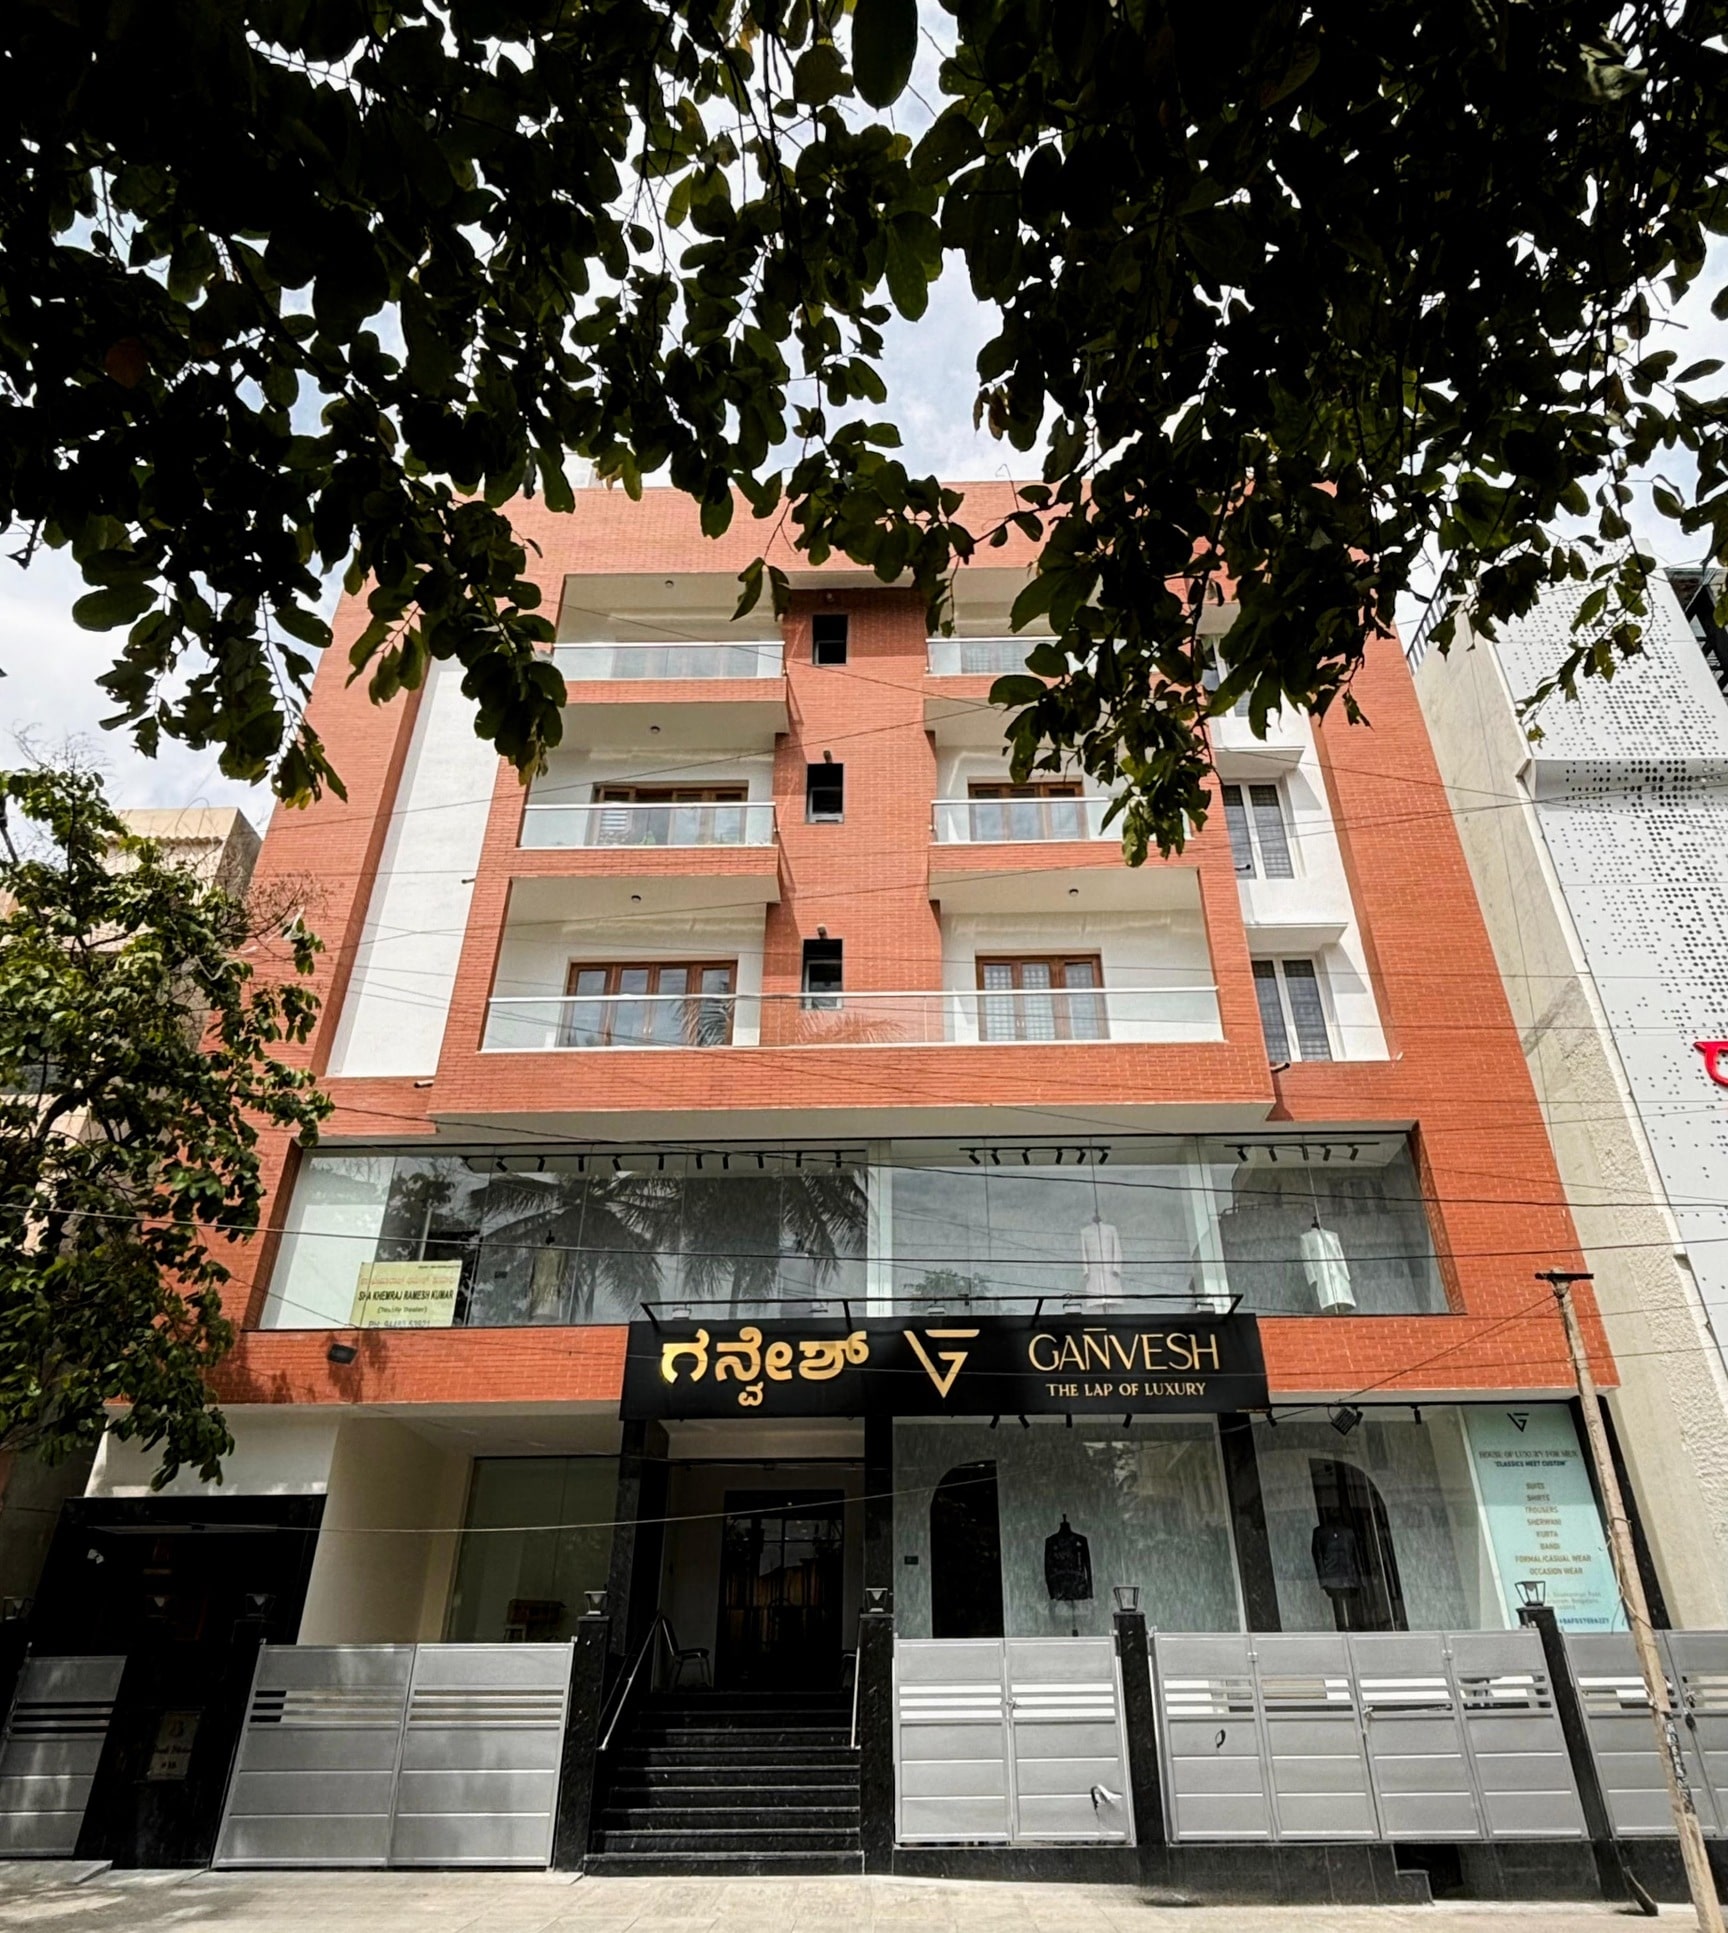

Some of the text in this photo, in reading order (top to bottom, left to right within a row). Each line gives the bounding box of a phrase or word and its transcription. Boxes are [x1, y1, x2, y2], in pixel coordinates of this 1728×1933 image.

[373, 1291, 402, 1301] KHEMRAJ
[403, 1290, 430, 1300] RAMESH
[431, 1290, 454, 1299] KUMAR
[1046, 1382, 1206, 1397] THE LAP OF LUXURY
[1479, 1450, 1501, 1459] HOUSE
[1504, 1450, 1514, 1458] OF
[1515, 1450, 1543, 1458] LUXURY
[1545, 1450, 1560, 1458] FOR
[1527, 1494, 1550, 1502] SHIRTS
